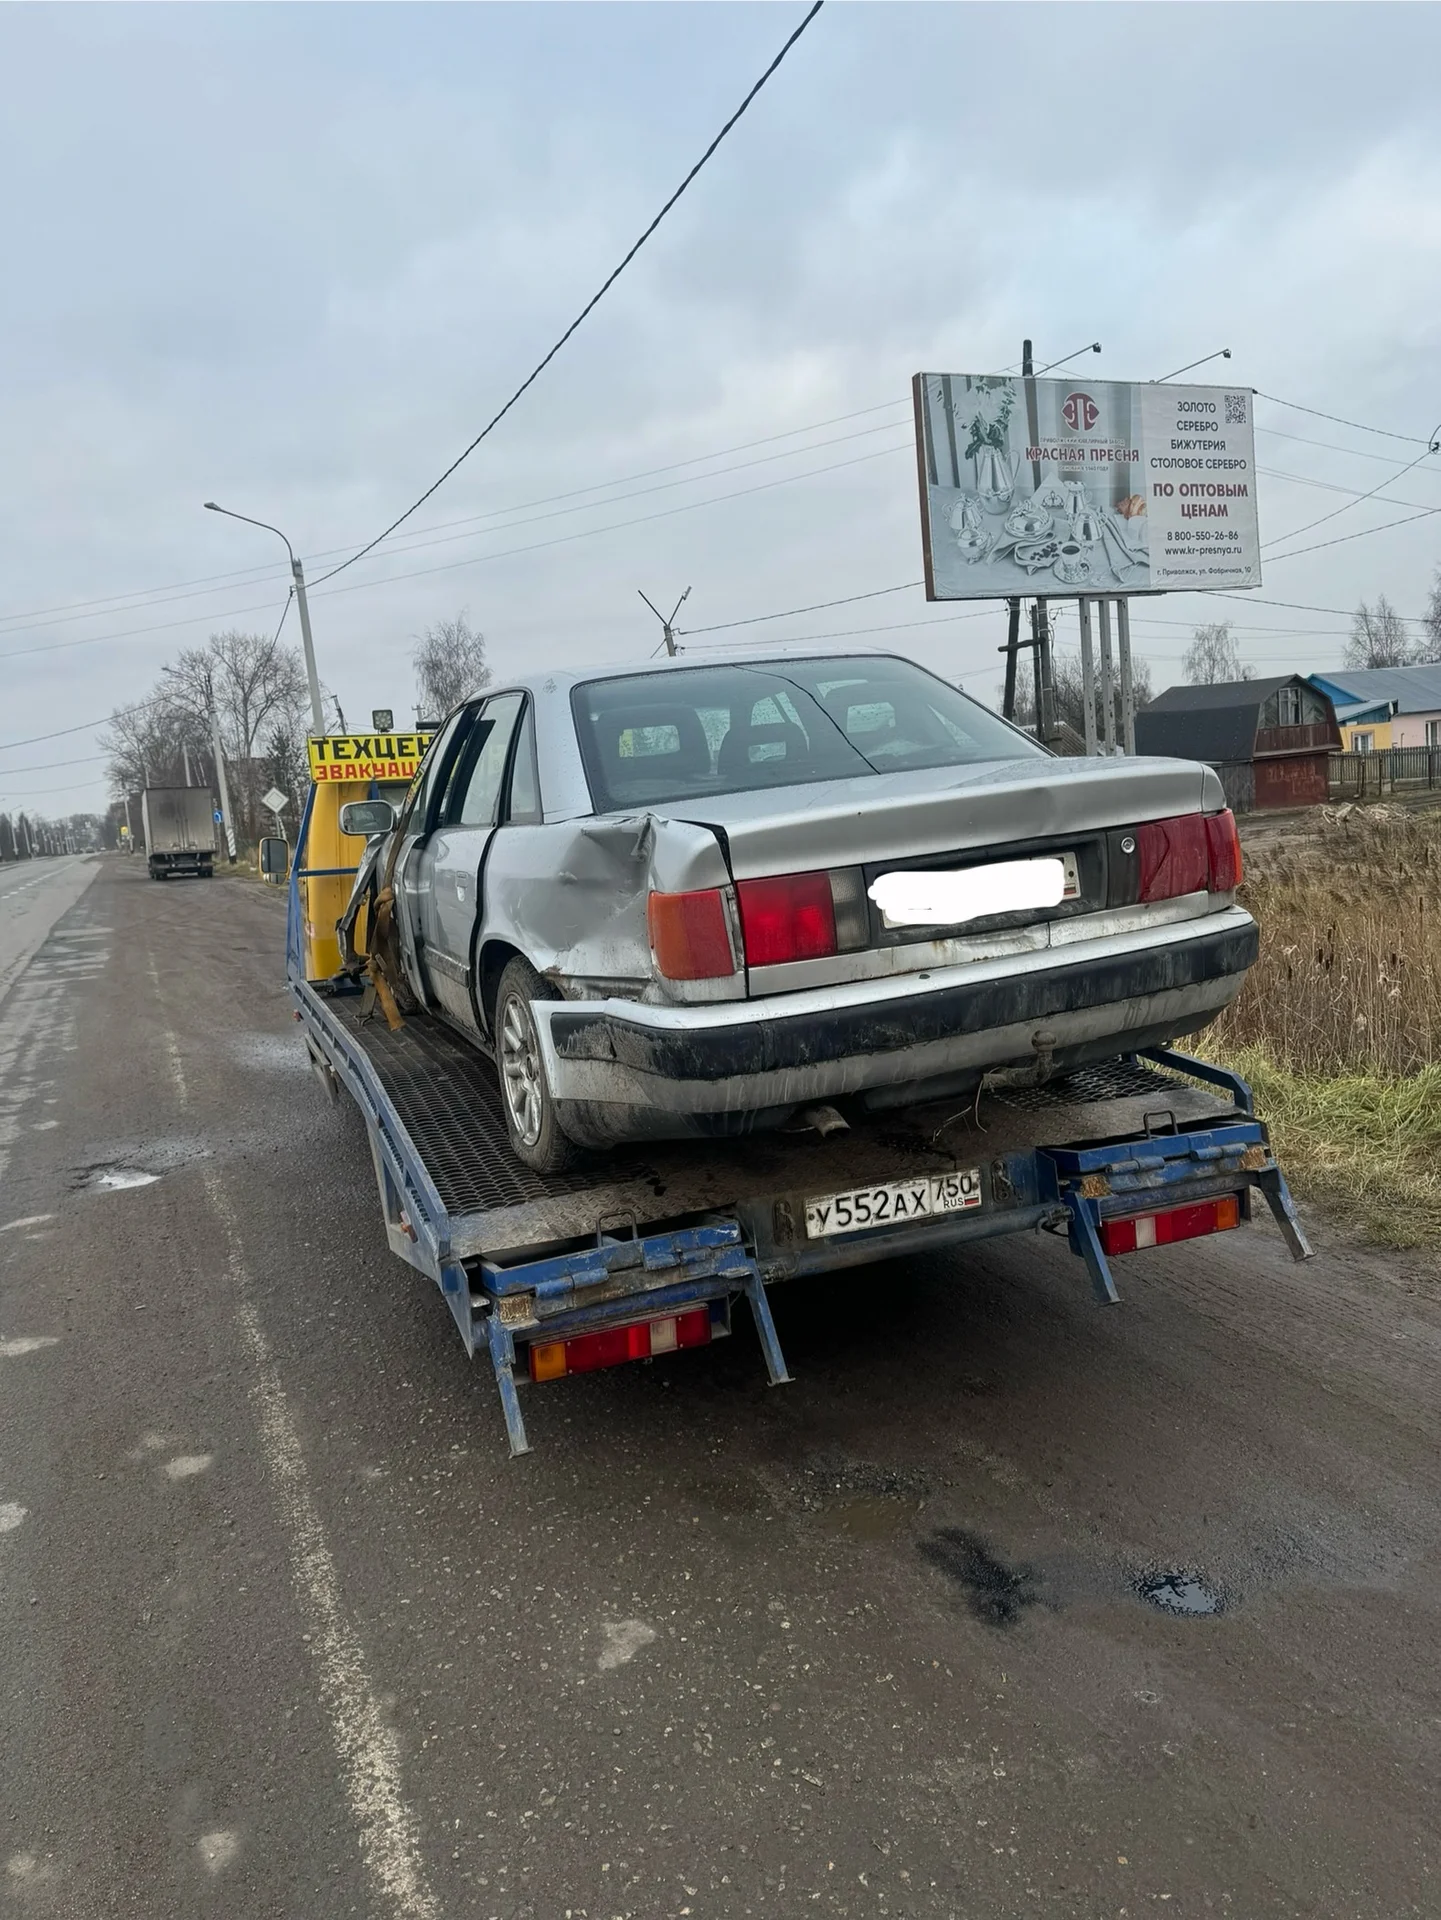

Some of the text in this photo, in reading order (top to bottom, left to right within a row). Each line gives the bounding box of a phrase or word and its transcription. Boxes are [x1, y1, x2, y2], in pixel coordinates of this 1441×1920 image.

[1177, 401, 1216, 413] ЗОЛОТО
[1176, 420, 1219, 431] СЕРЕБРО
[1170, 439, 1226, 451] БИЖУТЕРИЯ
[1025, 447, 1139, 462] КРАСНАЯ ПРЕСНЯ
[1150, 457, 1247, 470] СТОЛОВОЕ СЕРЕБРО
[1153, 483, 1248, 497] ПО ОПТОВЫМ
[1181, 504, 1228, 519] ЦЕНАМ
[1167, 531, 1239, 541] 8 800-550-26-86
[1164, 546, 1242, 556] www.kr-presnya.ru
[312, 736, 433, 761] ТЕХЦЕН
[315, 761, 421, 781] ЭВАКУАЦ
[815, 1175, 973, 1228] У552АХ 750
[943, 1197, 964, 1209] RUS
